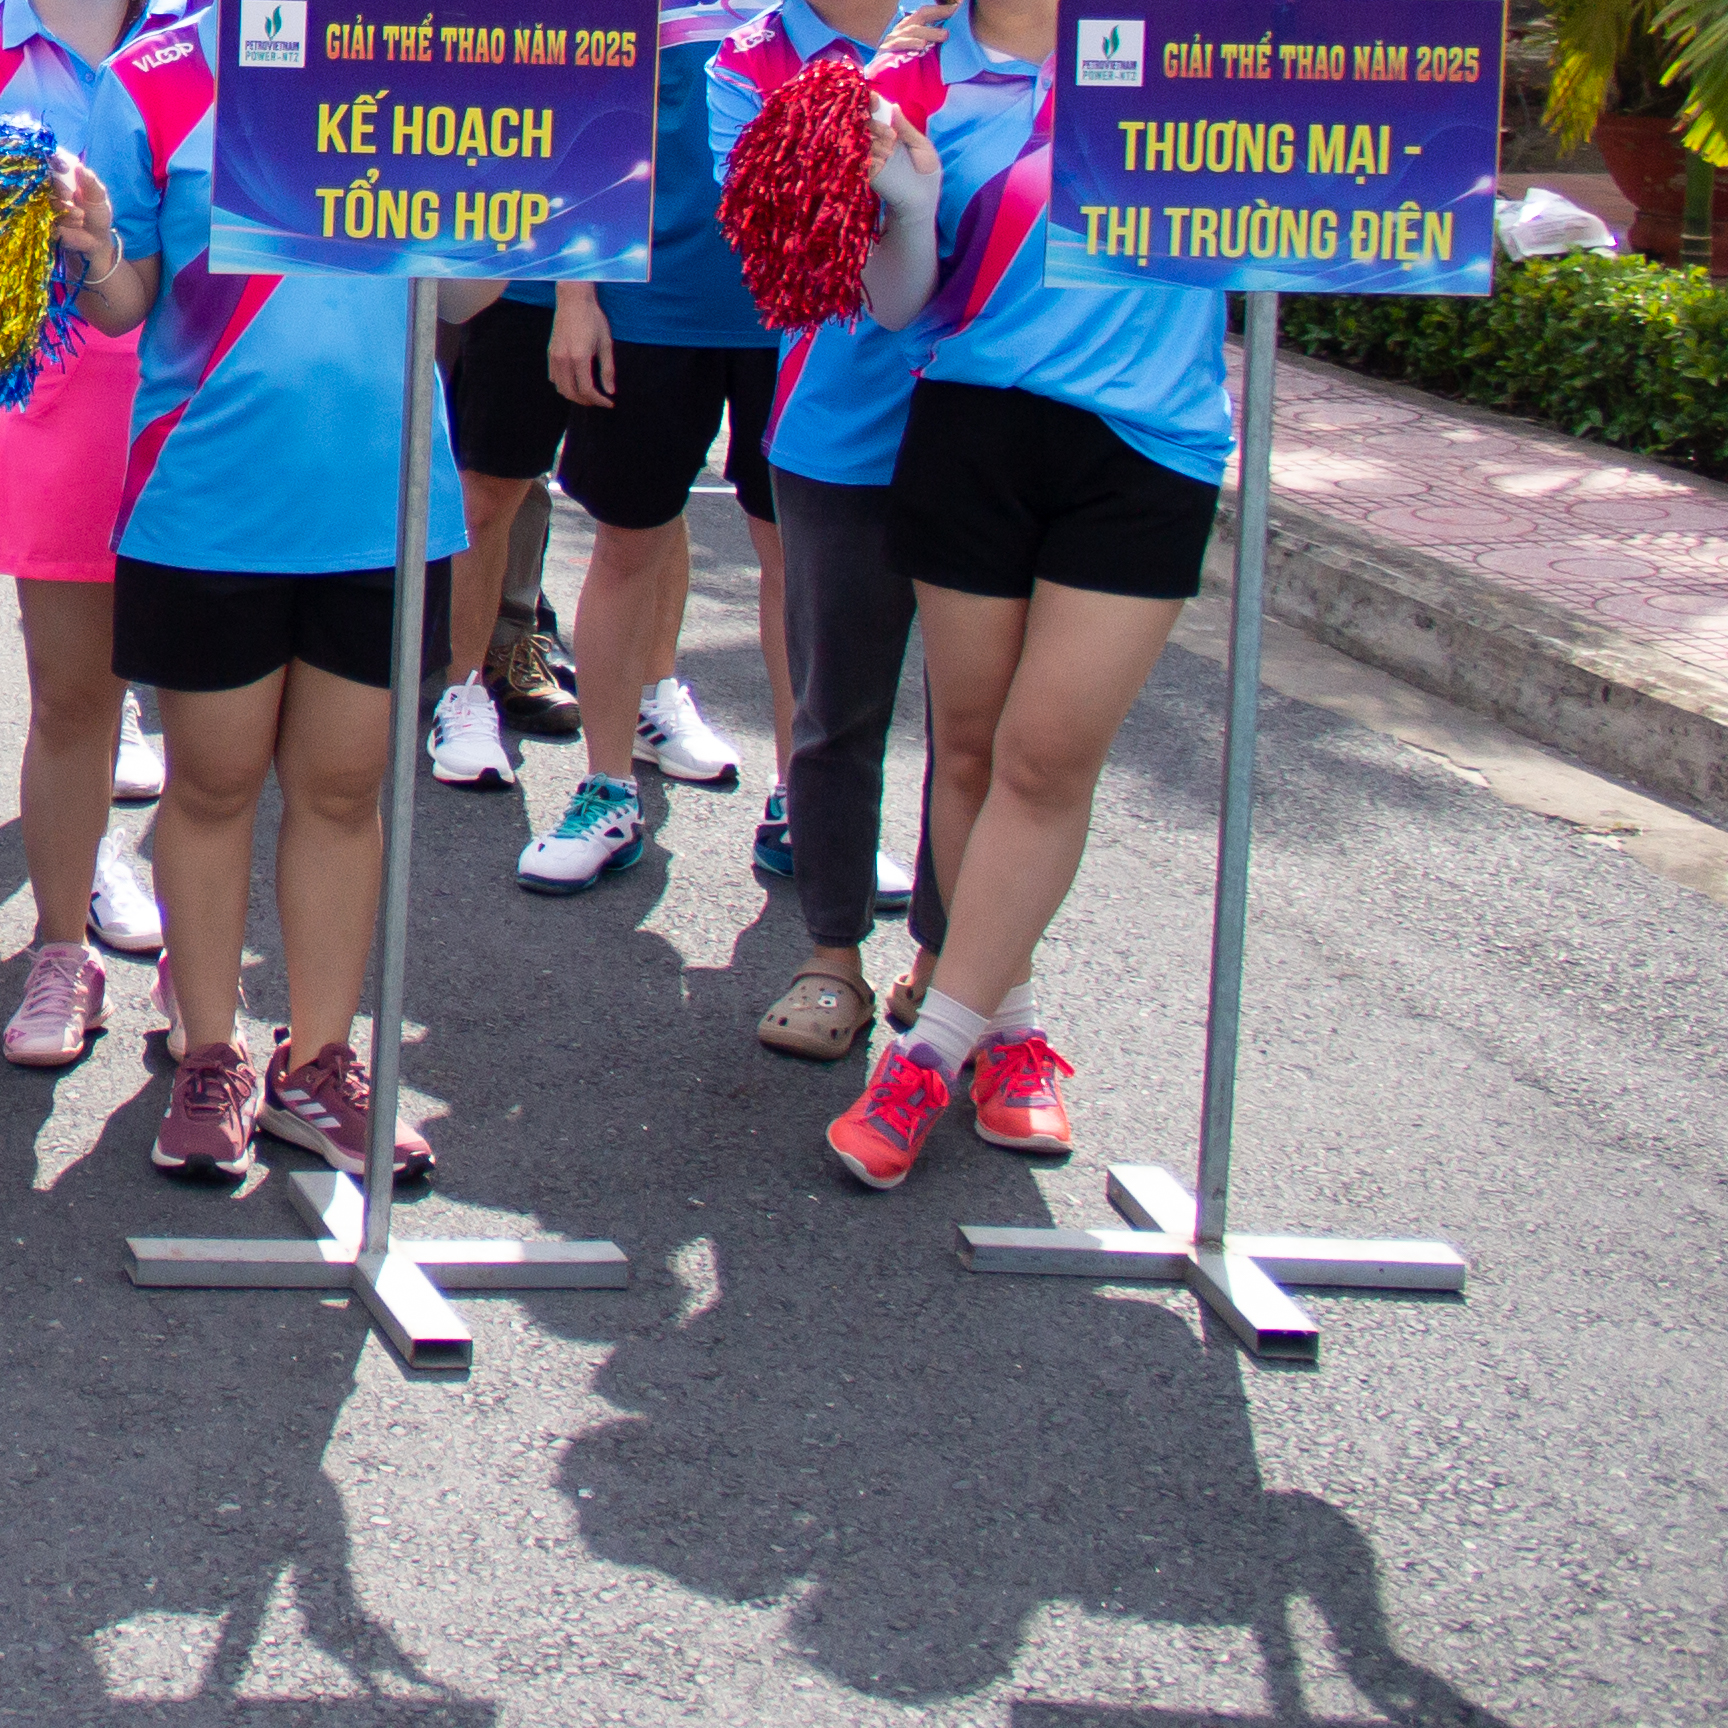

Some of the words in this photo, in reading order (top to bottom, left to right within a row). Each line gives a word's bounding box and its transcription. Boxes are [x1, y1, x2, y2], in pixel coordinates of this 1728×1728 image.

[132, 42, 194, 72] VLOOP
[326, 15, 374, 60] GIẢI
[383, 13, 433, 61] THỂ
[441, 27, 505, 64] THAO
[515, 24, 566, 65] NĂM
[575, 31, 636, 67] 2025
[1163, 33, 1213, 78] GIẢI
[1221, 31, 1272, 79] THỂ
[1279, 44, 1345, 80] THAO
[1353, 41, 1408, 81] NĂM
[1416, 47, 1480, 82] 2025
[317, 90, 389, 154] KẾ
[392, 105, 553, 166] HOẠCH
[1118, 120, 1294, 173] THƯƠNG
[1307, 124, 1390, 184] MẠI
[315, 169, 440, 240] TỔNG
[454, 192, 549, 251] HỢP
[1080, 206, 1150, 267] THỊ
[1163, 199, 1339, 259] TRƯỜNG
[1350, 202, 1452, 271] ĐIỆN
